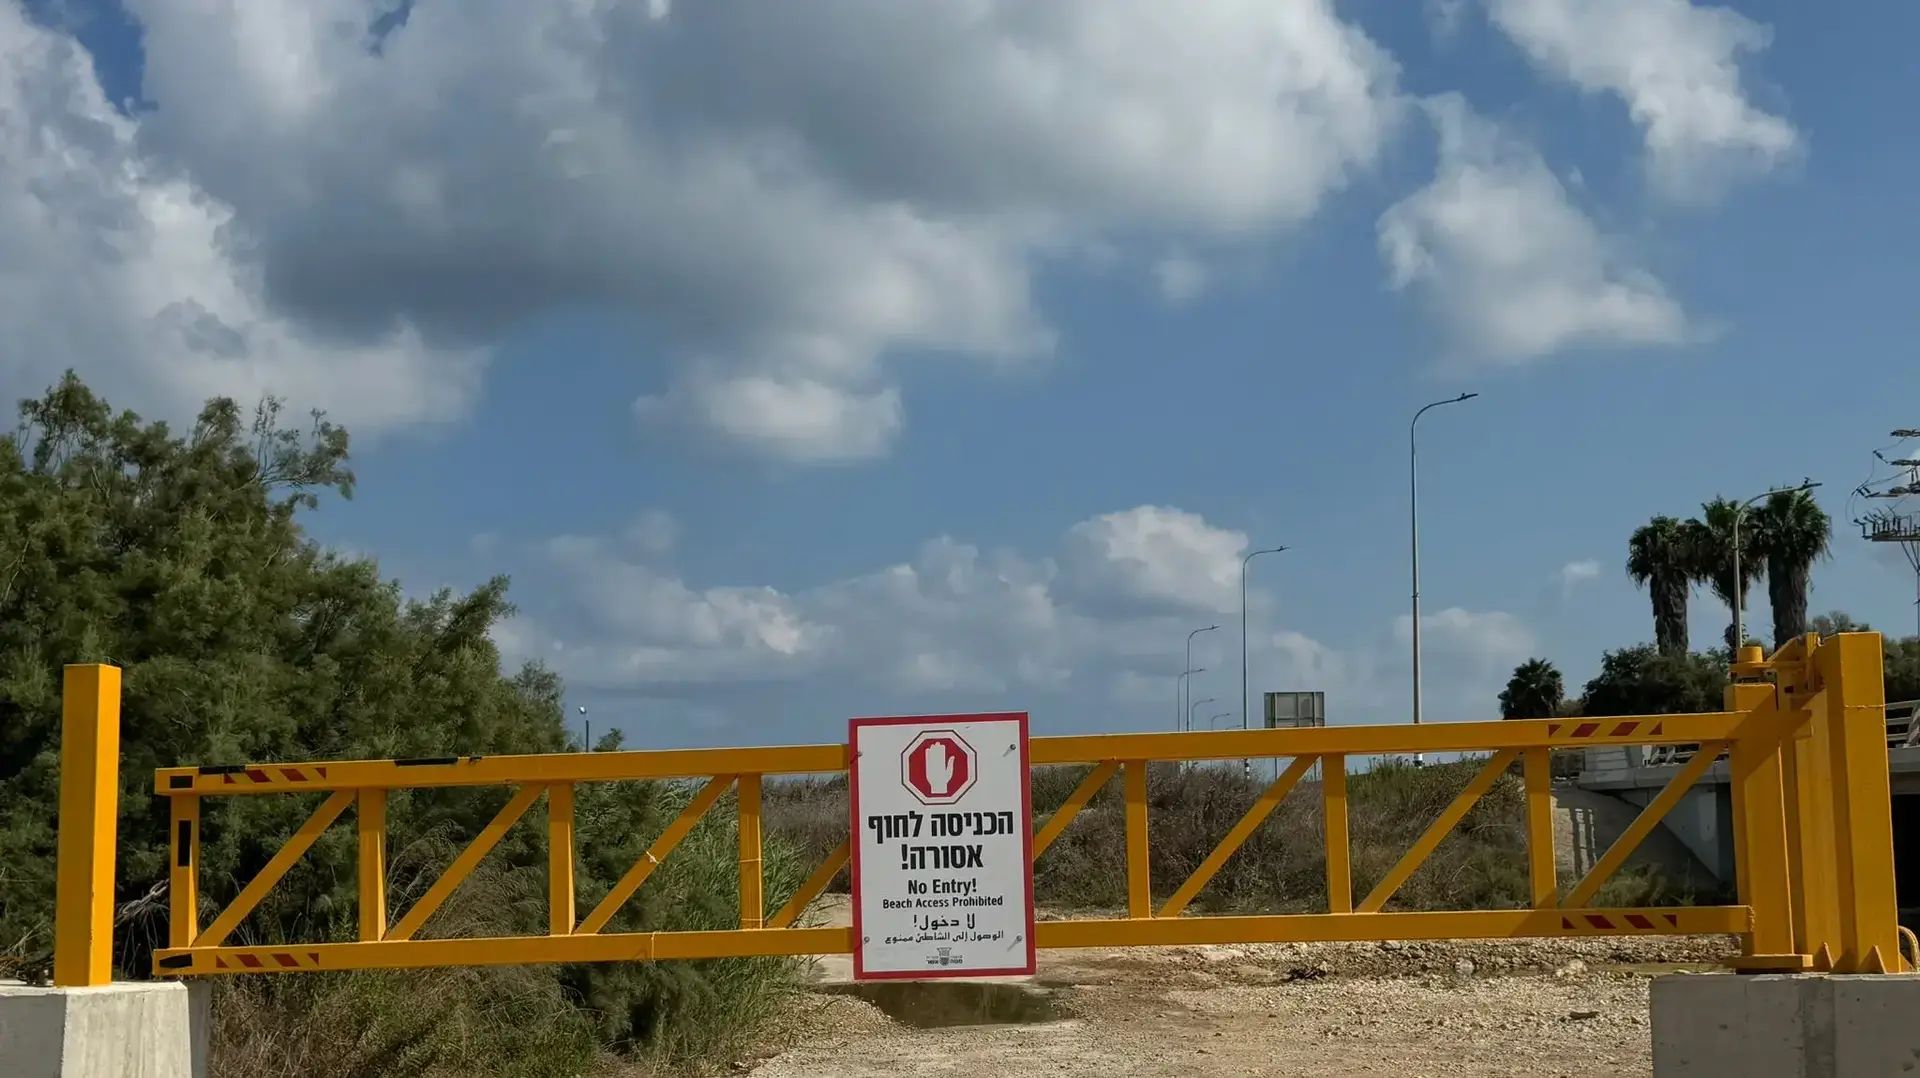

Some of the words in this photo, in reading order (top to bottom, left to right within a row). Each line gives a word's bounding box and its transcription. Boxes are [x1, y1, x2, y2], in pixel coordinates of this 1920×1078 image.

[867, 810, 924, 844] לחוף
[930, 811, 1014, 837] הכניסה
[901, 843, 984, 870] אסורה!
[907, 879, 928, 895] No
[932, 877, 977, 897] Entry!
[882, 898, 913, 909] Beach
[915, 897, 950, 909] Access
[952, 895, 1004, 907] Prohibited
[966, 912, 976, 930] لا
[884, 934, 914, 945] ممنوع
[969, 930, 1004, 943] الوصول
